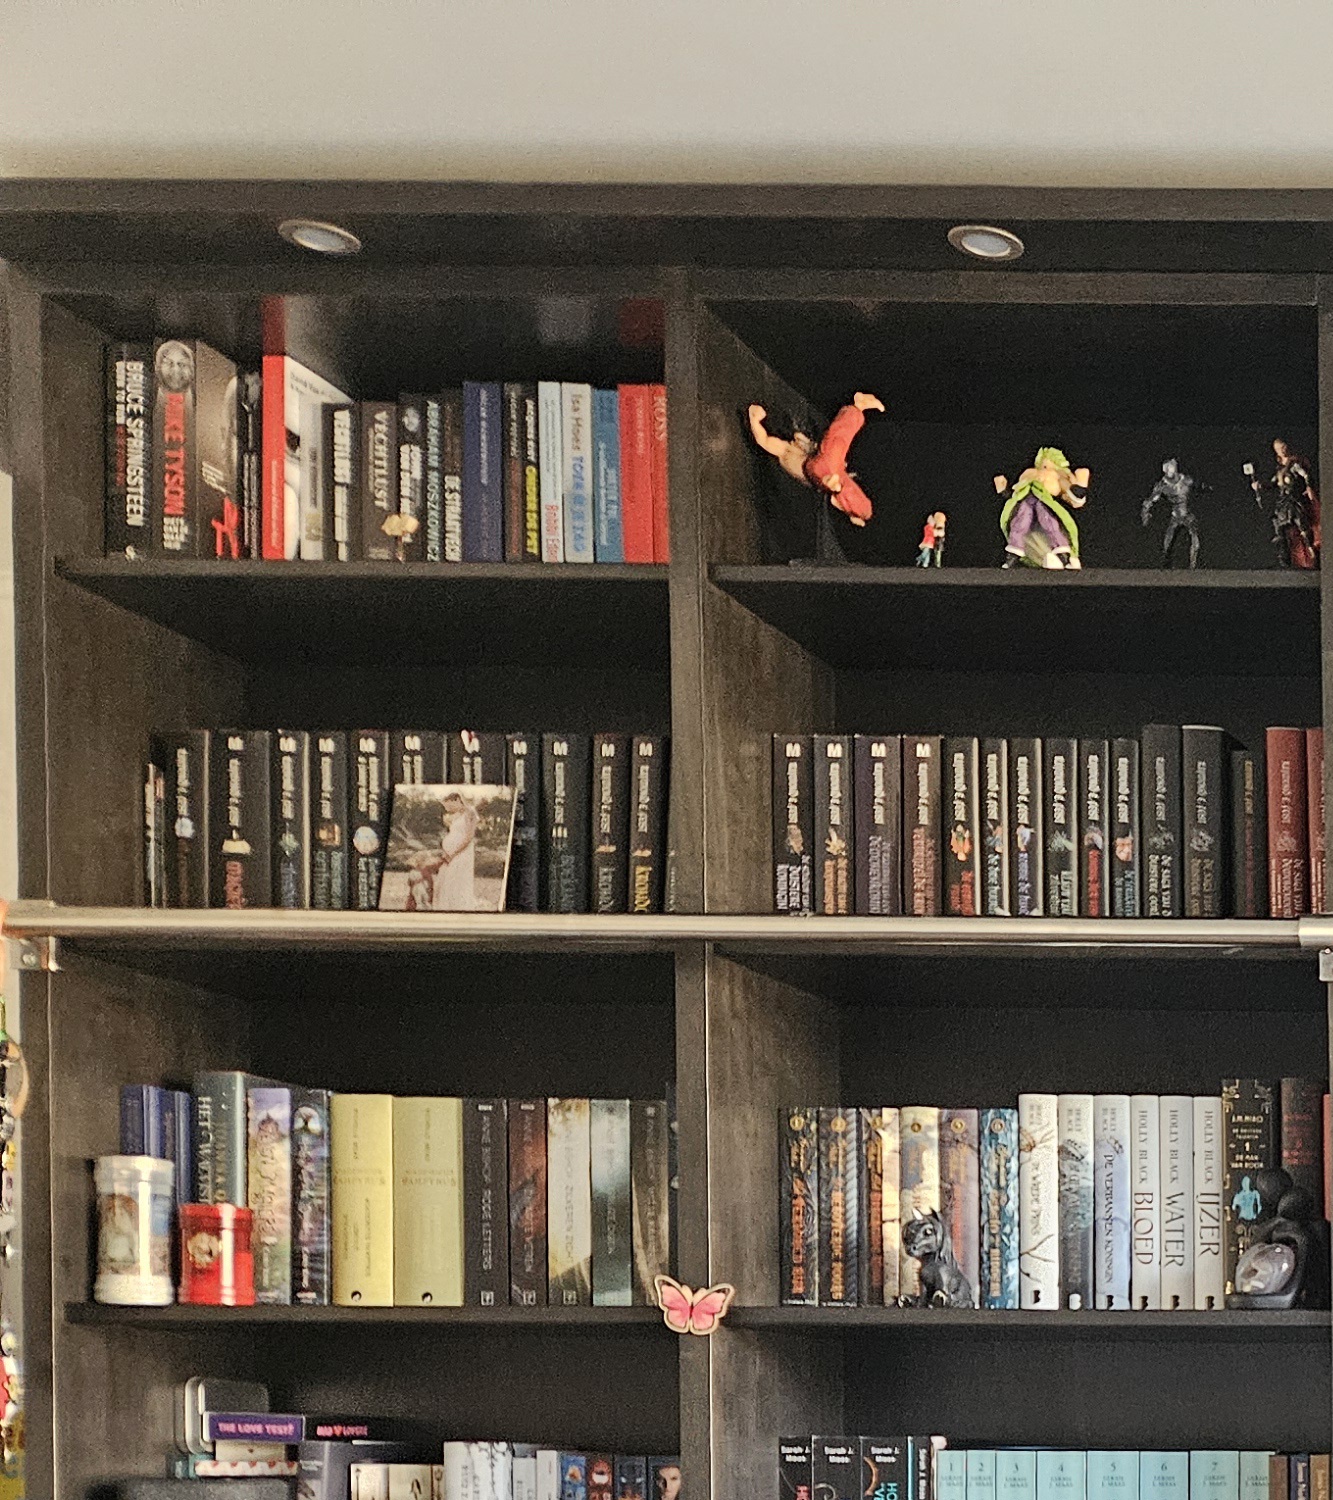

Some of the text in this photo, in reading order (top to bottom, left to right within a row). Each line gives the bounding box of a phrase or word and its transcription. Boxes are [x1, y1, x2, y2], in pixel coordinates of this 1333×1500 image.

[127, 362, 143, 525] BRUCE SPRINGSTEEN
[165, 393, 184, 514] MIKE TYSON
[481, 1189, 491, 1270] RODE LETTERS
[1133, 1110, 1154, 1265] HOLLY BLACK BLOED
[1164, 1110, 1186, 1268] HOLLY BLACK WATER
